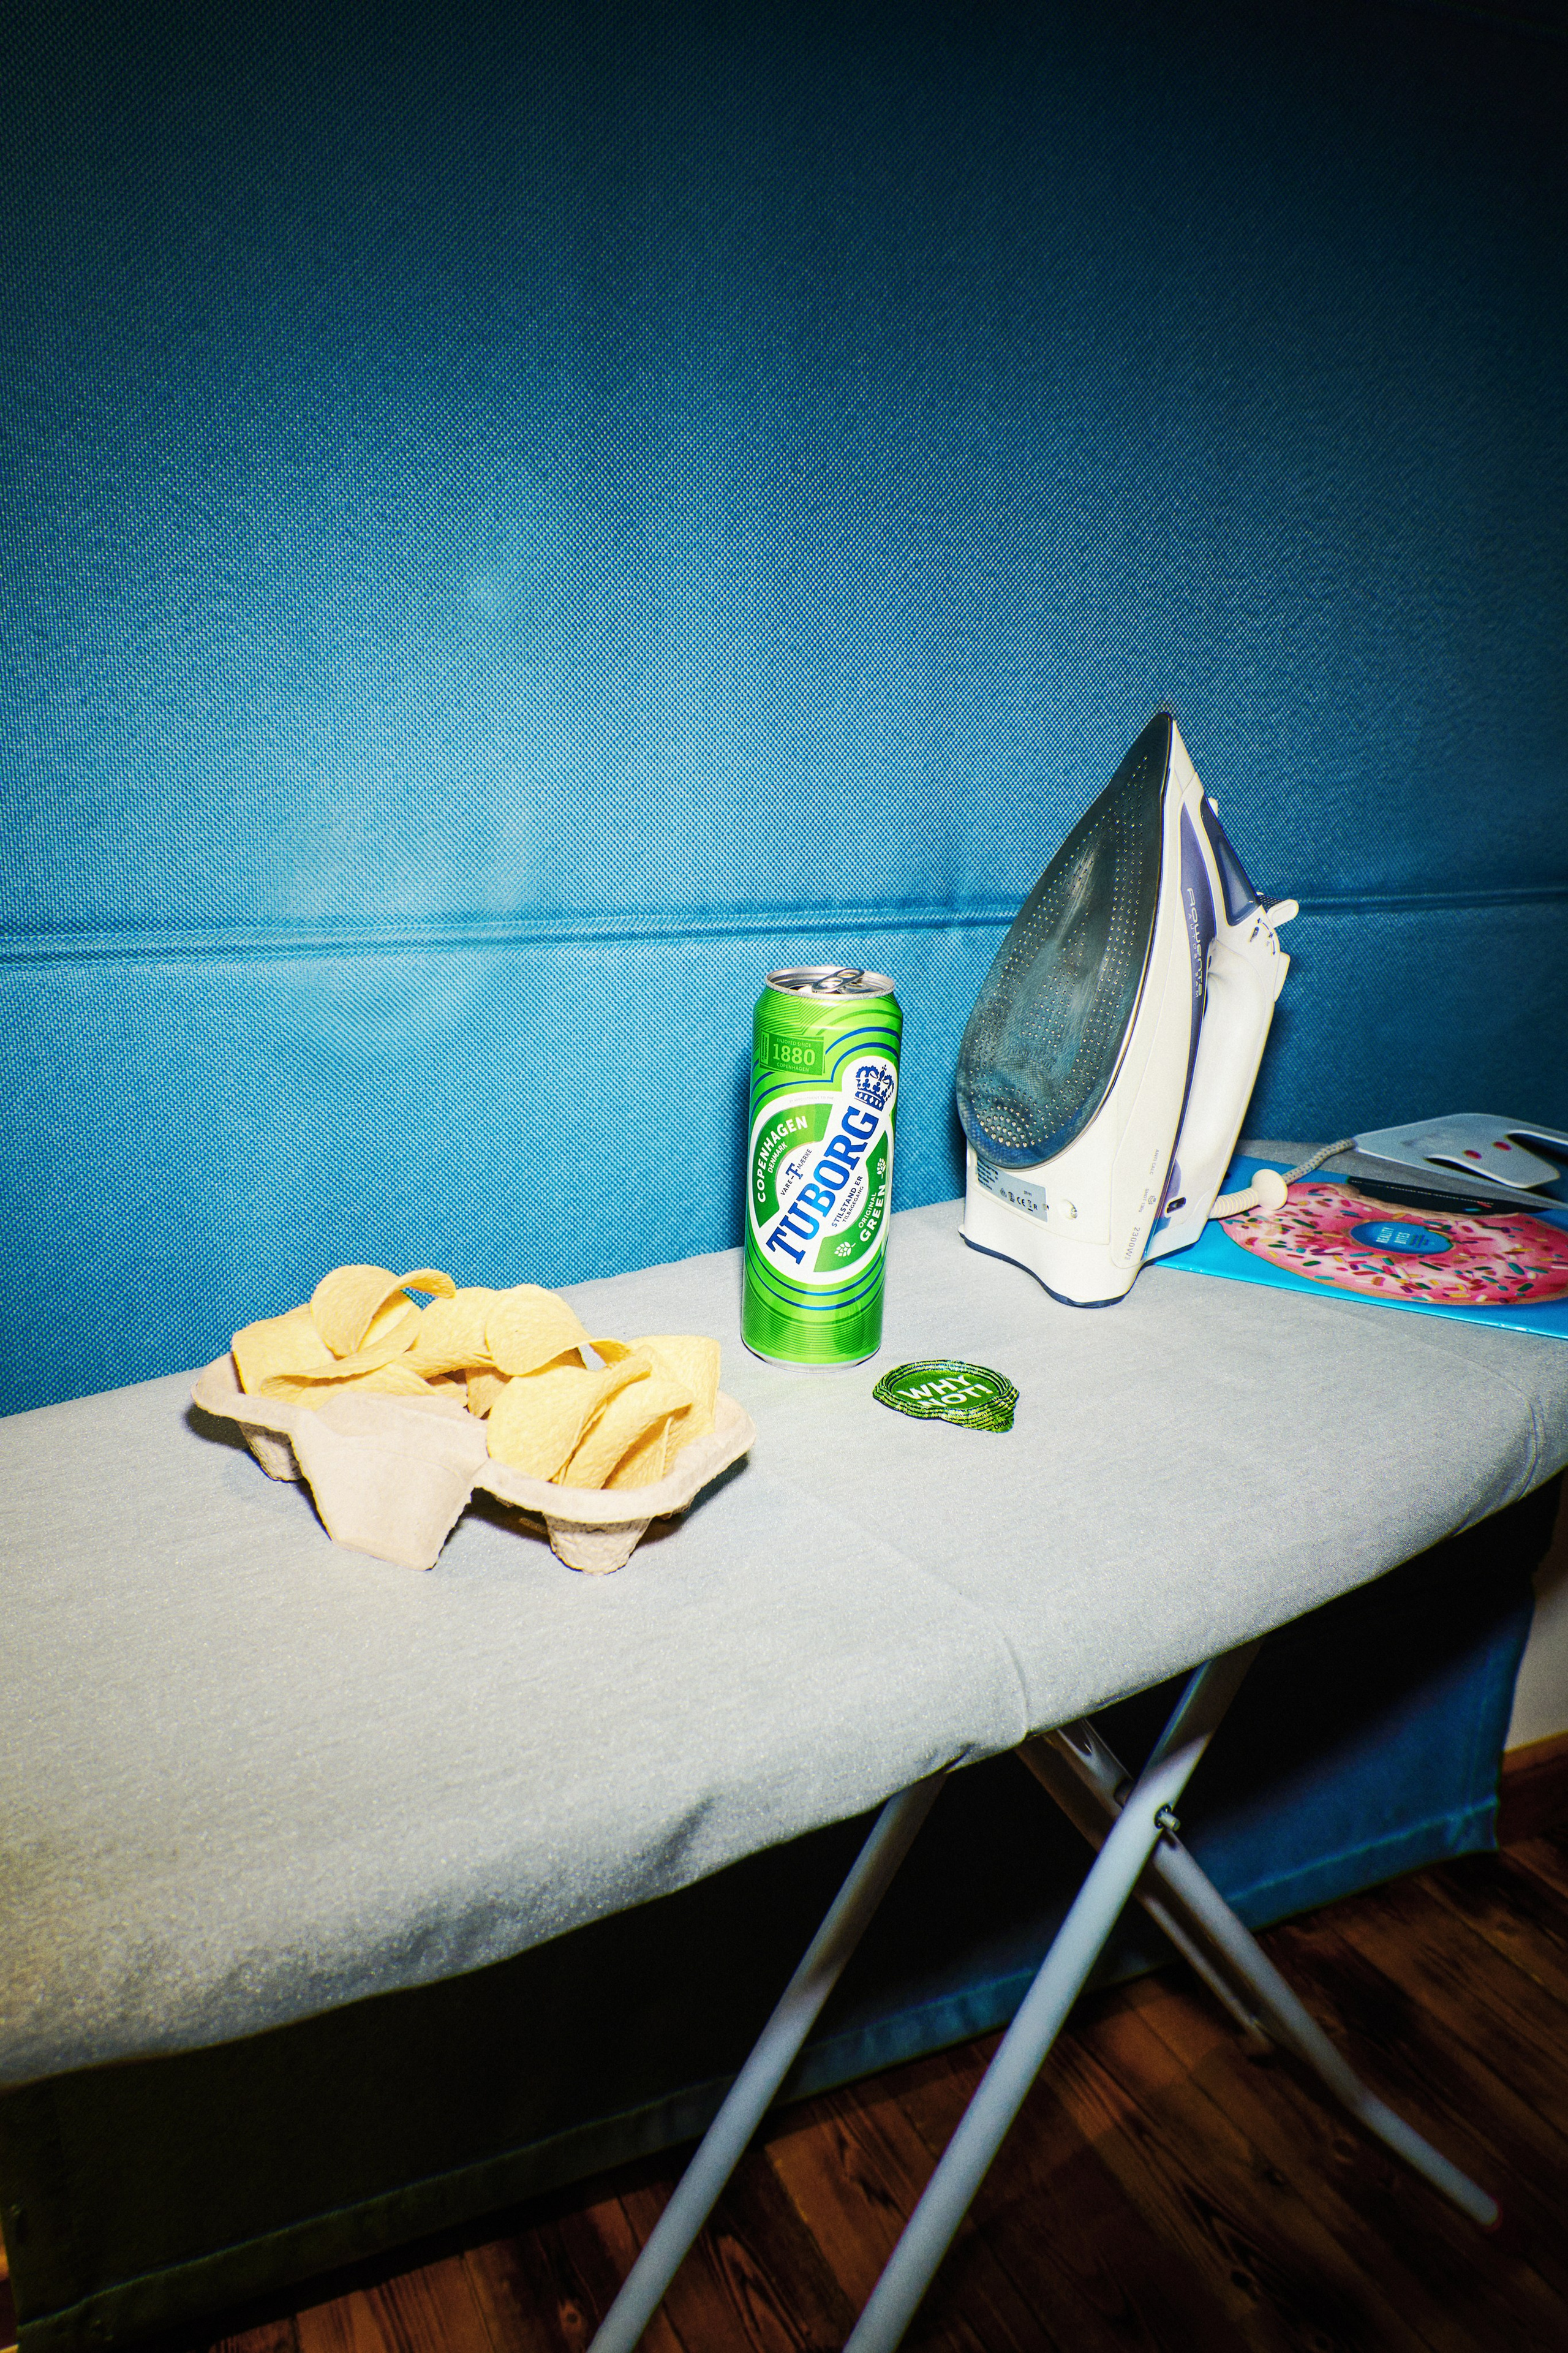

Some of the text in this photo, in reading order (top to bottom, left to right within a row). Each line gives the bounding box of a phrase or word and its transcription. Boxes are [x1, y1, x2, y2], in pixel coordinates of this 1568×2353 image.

[773, 1043, 816, 1066] 1880
[777, 1037, 797, 1046] ENJOYED
[777, 1062, 810, 1072] COPENHAGEN
[756, 1116, 808, 1203] COPENHAGEN
[767, 1141, 788, 1173] DENMARK
[766, 1105, 879, 1264] TUBORG
[831, 1176, 863, 1227] STILSTAND ER
[842, 1186, 864, 1222] TILBAGEGANG
[858, 1192, 876, 1228] ORIGINAL
[859, 1184, 886, 1242] GREEN
[1125, 1227, 1140, 1257] 2300W
[896, 1375, 972, 1400] WHY
[918, 1383, 993, 1407] NOT!
[993, 1419, 1011, 1430] OPEN
